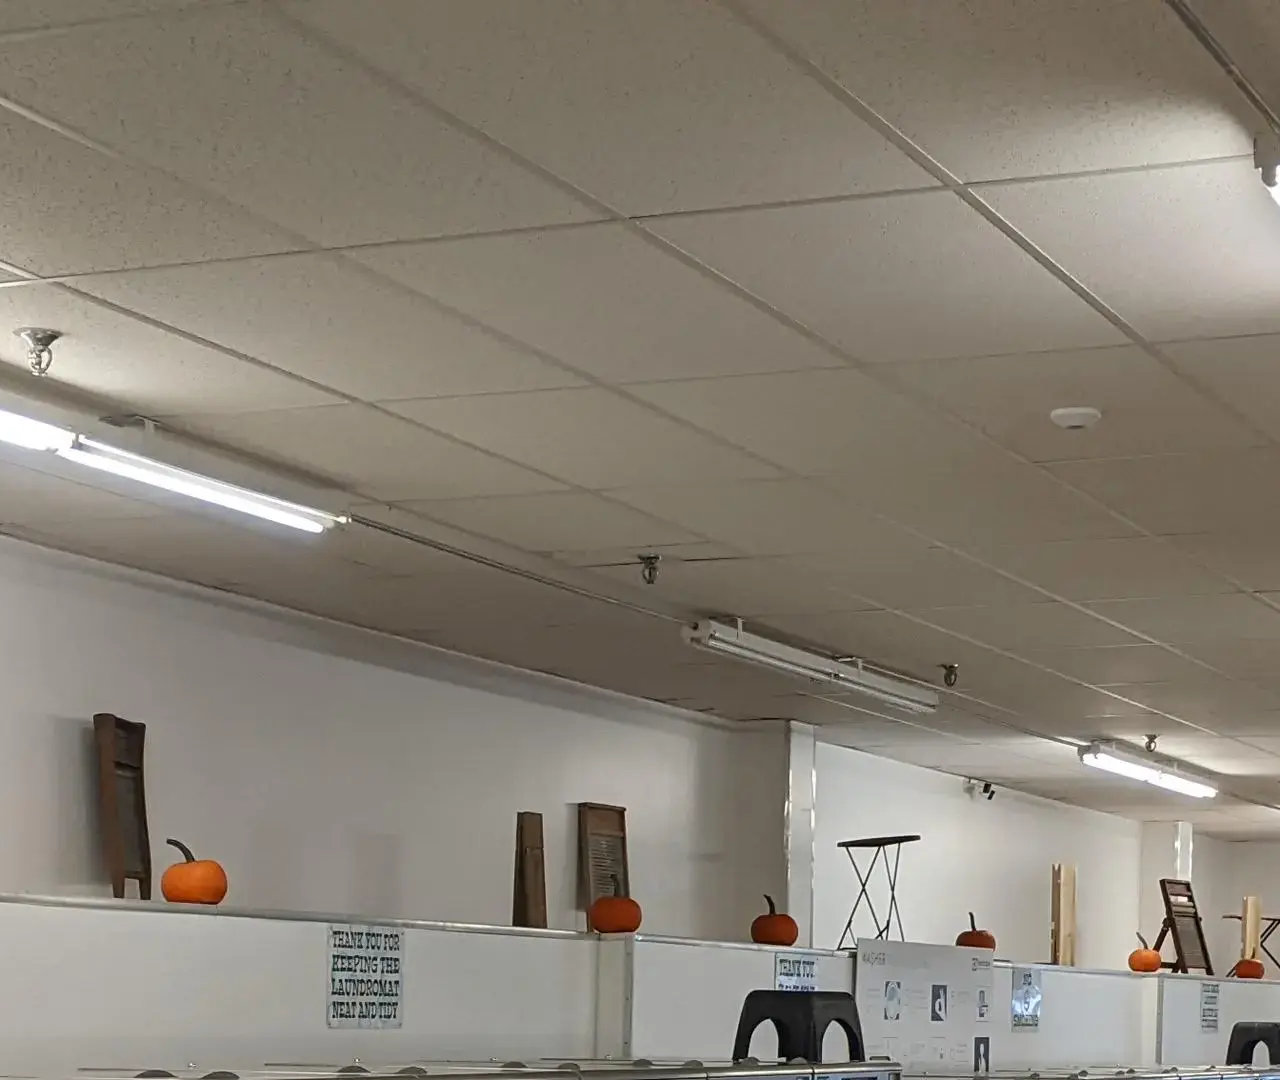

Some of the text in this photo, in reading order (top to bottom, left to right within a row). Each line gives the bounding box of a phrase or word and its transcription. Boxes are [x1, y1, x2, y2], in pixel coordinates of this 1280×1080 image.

[332, 930, 400, 951] THANK YOU FOR
[332, 954, 400, 974] KEEPING THE
[331, 978, 400, 997] LAUNDROMAT
[332, 1001, 398, 1019] NEAT AND TIDY
